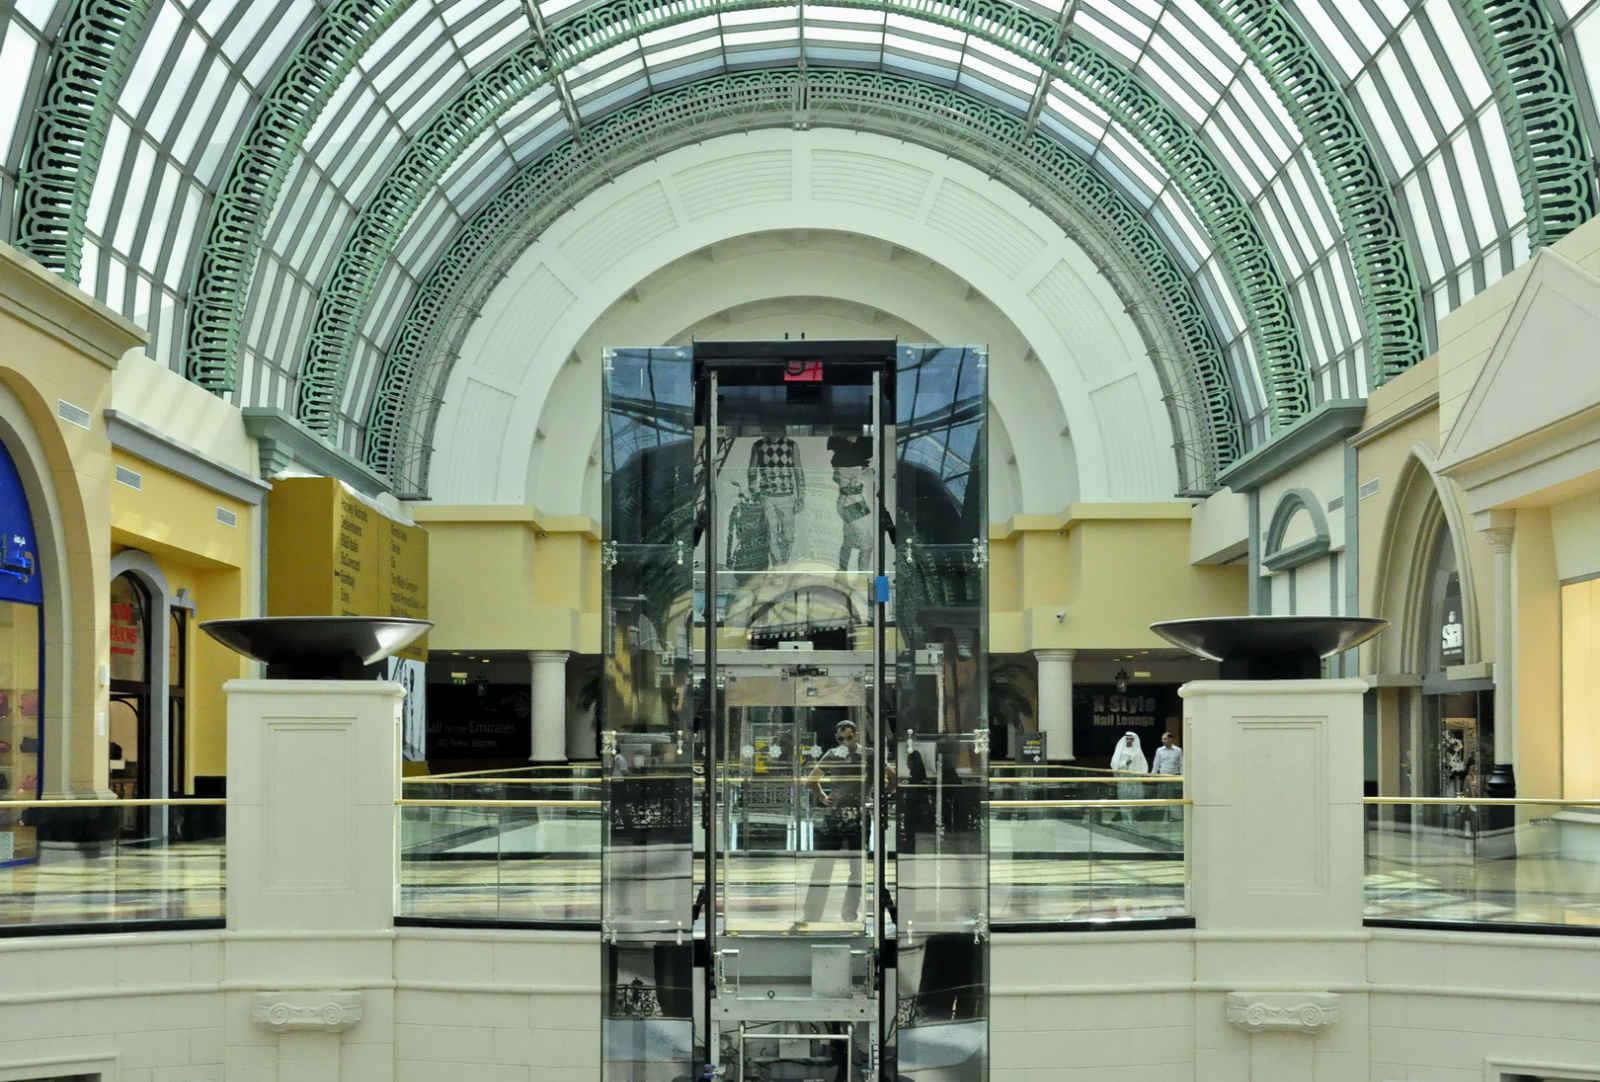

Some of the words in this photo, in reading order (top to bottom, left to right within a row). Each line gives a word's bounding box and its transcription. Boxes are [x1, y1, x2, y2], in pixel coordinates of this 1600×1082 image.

[1109, 695, 1156, 714] Style
[469, 720, 517, 734] Emirates
[1093, 714, 1114, 726] Nail
[1116, 714, 1155, 727] Lounge
[471, 738, 497, 748] Stores
